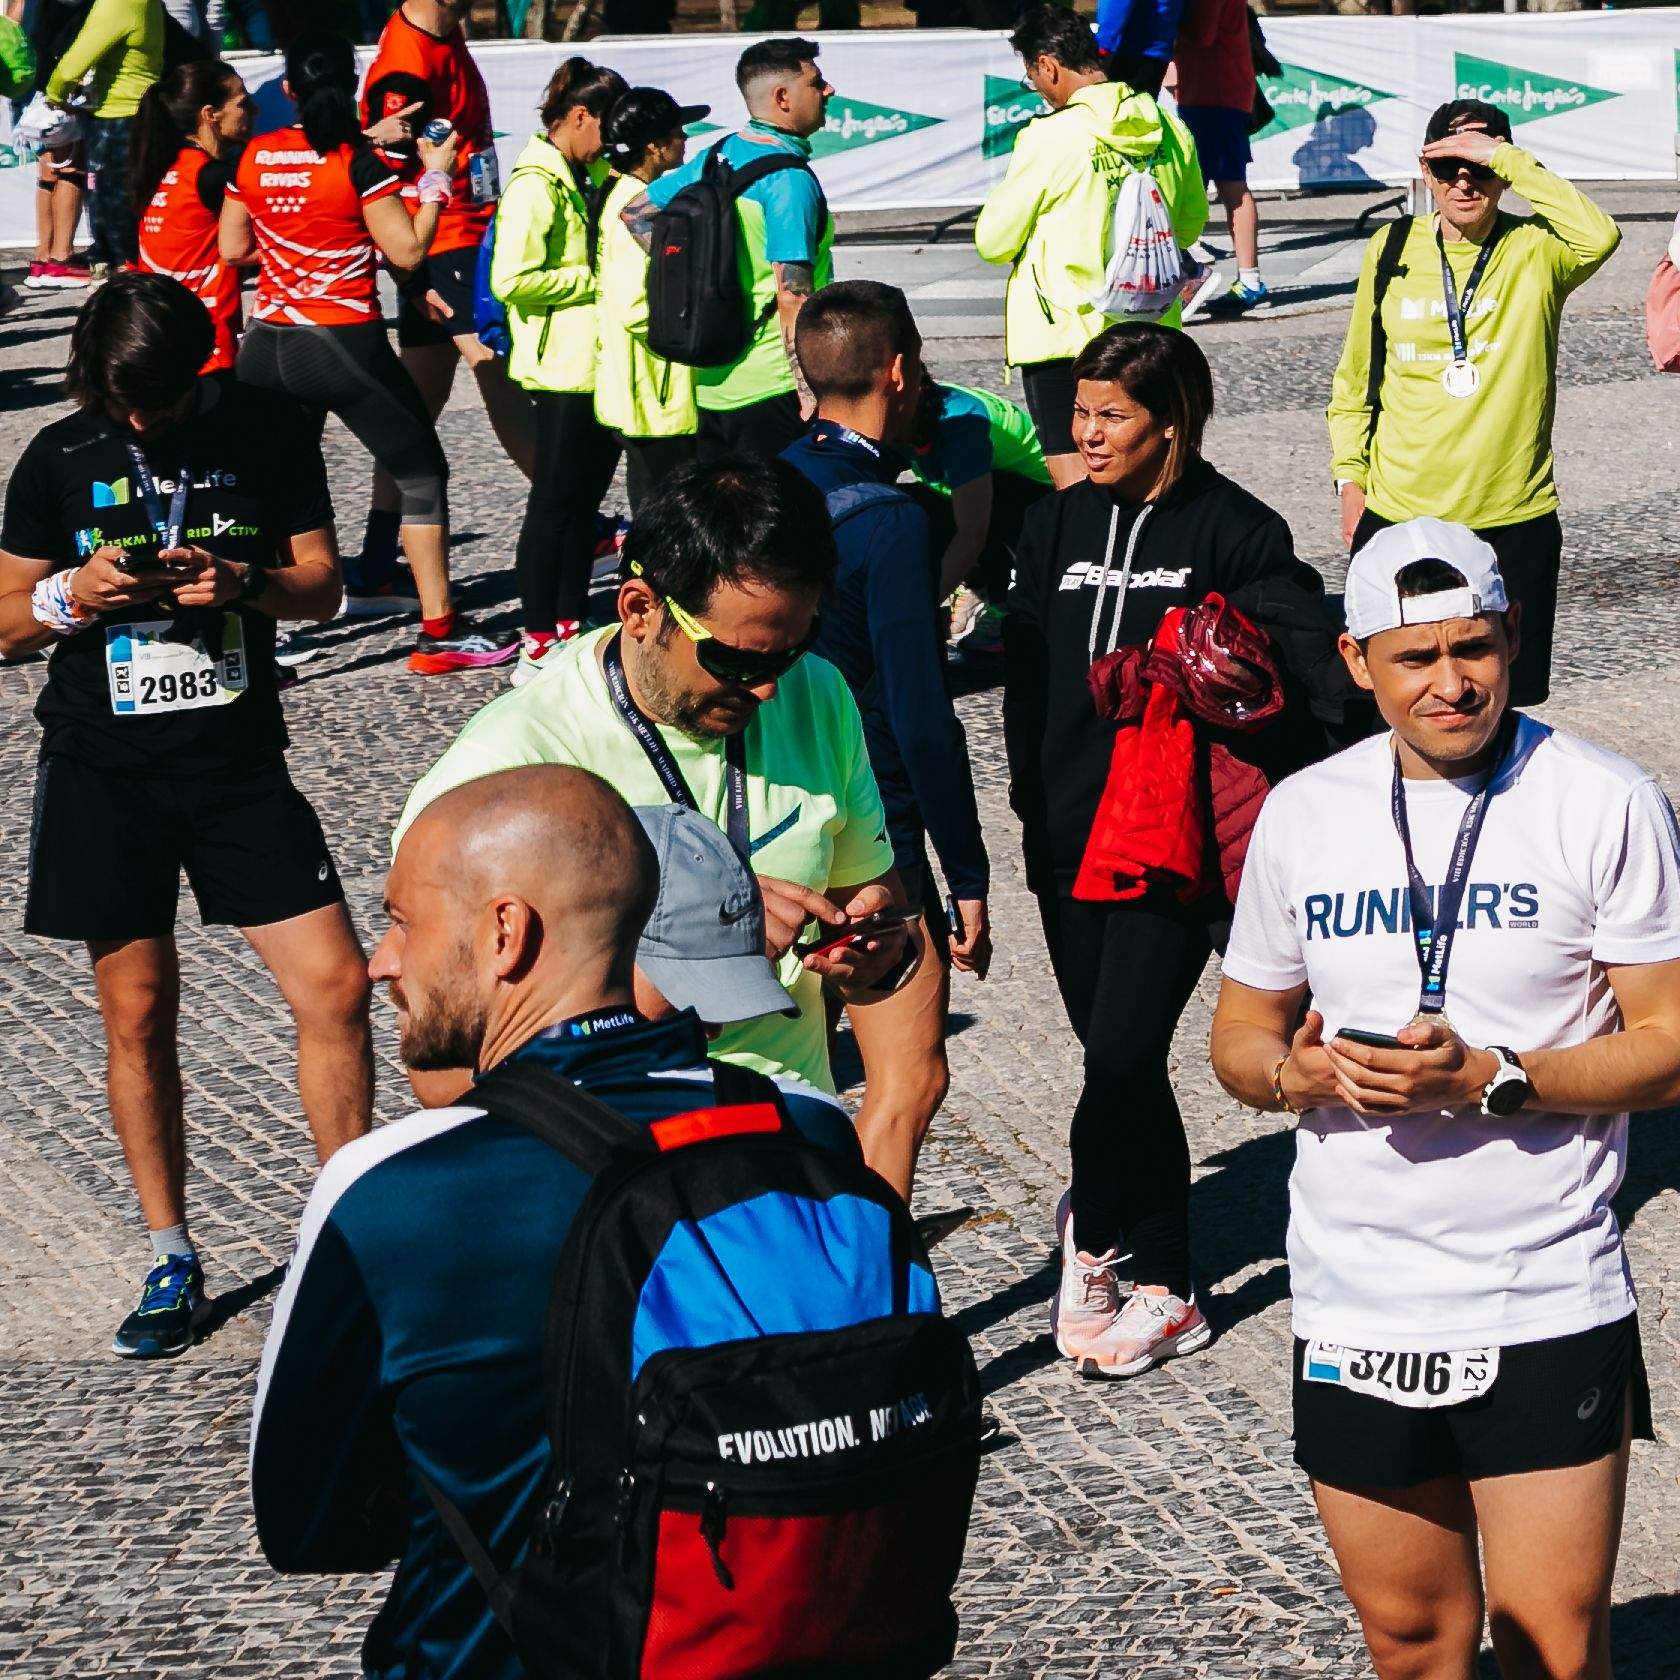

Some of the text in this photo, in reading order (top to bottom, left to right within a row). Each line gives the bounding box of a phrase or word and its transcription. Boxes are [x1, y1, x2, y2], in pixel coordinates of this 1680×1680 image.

[1307, 80, 1372, 111] Inglés
[1457, 80, 1586, 111] El Corte Inglés
[841, 108, 908, 139] Inglés
[986, 105, 1006, 126] El
[255, 149, 327, 166] RUNNING
[260, 171, 313, 189] RIVAS
[140, 669, 217, 705] 2983
[1452, 867, 1463, 883] VIII
[1431, 934, 1448, 976] MetLife
[593, 1013, 634, 1033] MetLife
[1350, 1351, 1452, 1395] 3206
[1463, 1353, 1489, 1392] 121
[718, 1415, 861, 1465] EVOLUTION.
